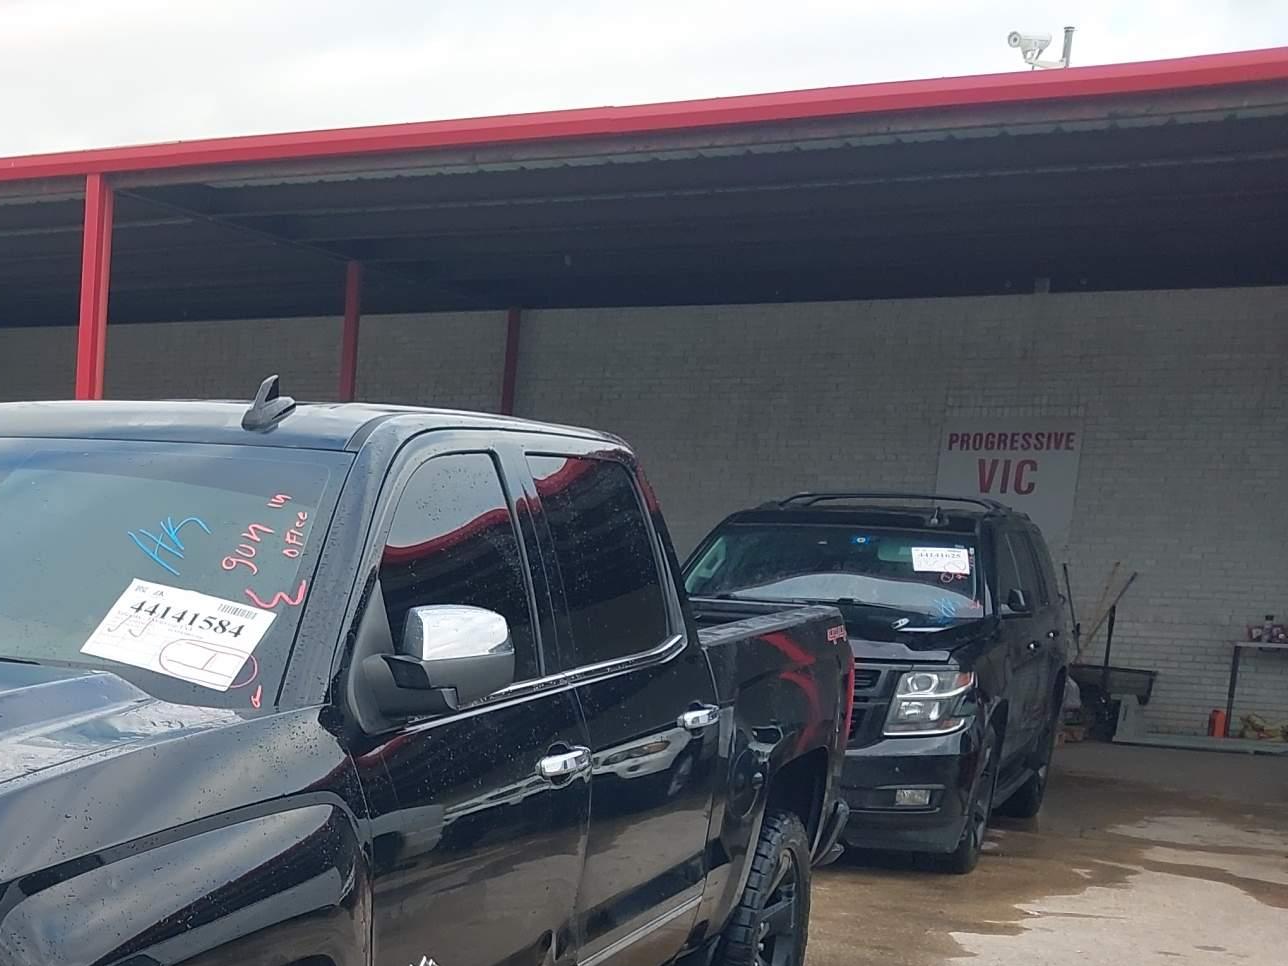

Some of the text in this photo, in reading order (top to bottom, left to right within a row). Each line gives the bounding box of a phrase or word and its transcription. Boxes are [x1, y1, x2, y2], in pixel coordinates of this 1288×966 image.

[948, 432, 1076, 451] PROGRESSIVE
[978, 458, 1038, 495] VIC
[130, 600, 246, 639] 44141584
